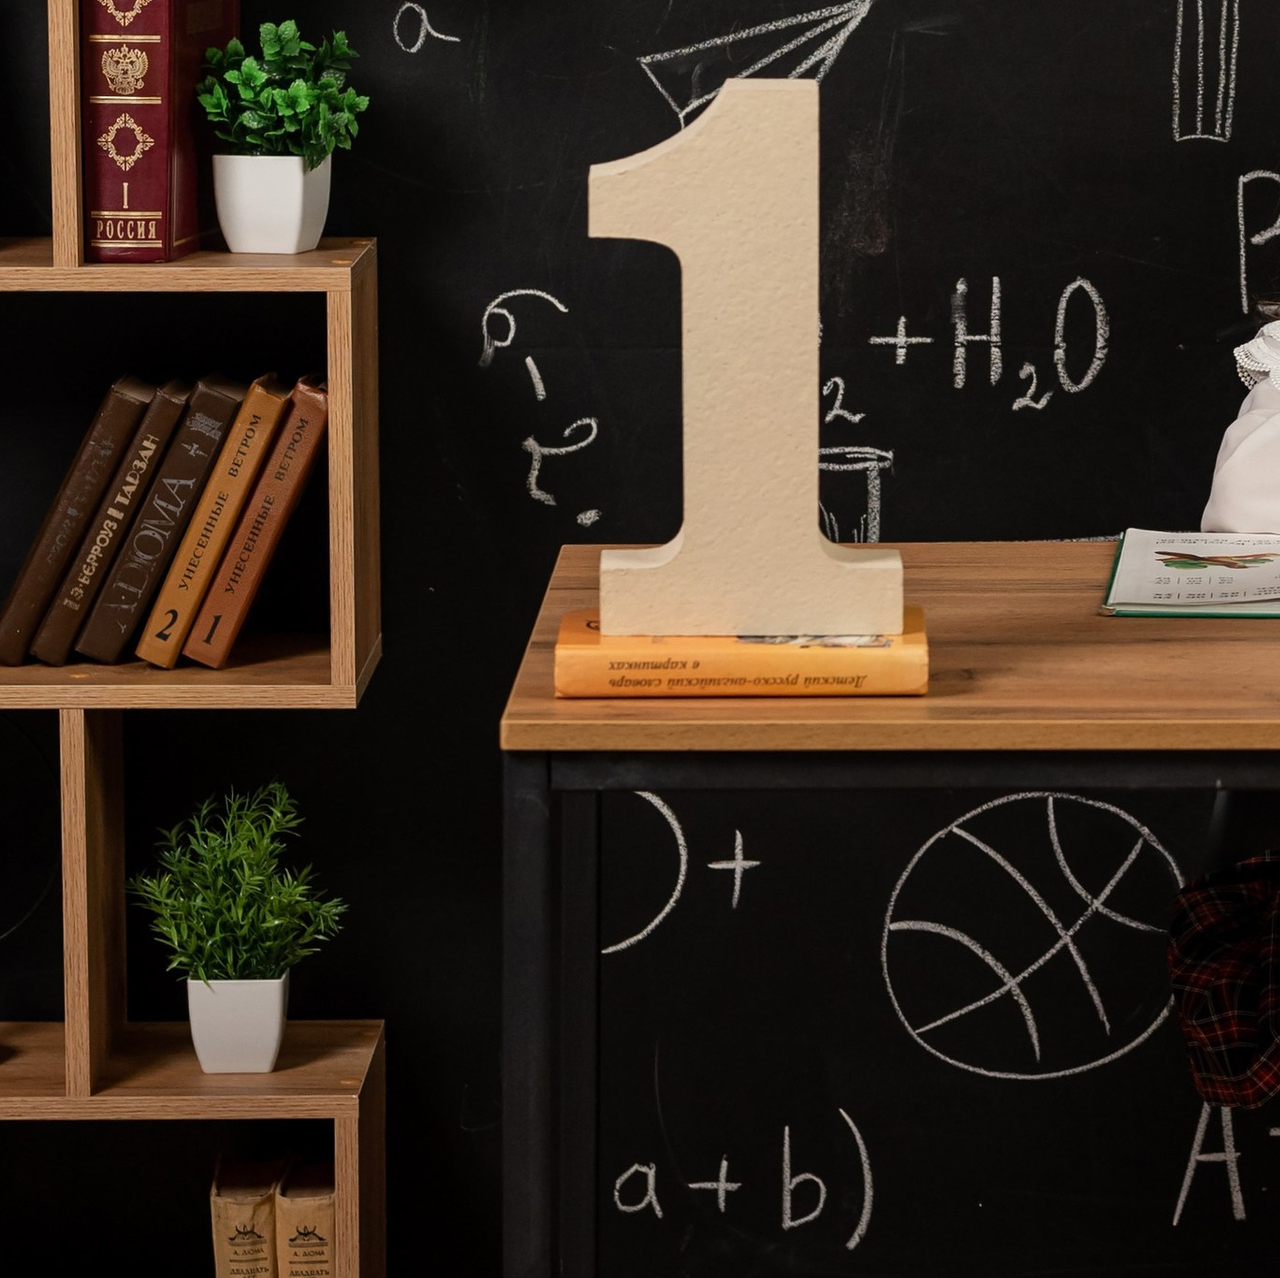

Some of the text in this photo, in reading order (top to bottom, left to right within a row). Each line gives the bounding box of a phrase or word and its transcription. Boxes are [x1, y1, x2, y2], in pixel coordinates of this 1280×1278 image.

[97, 220, 157, 239] РОССИЯ
[178, 490, 229, 591] УНЕСЕННЫЕ
[228, 413, 262, 478] ВЕТРОМ
[224, 417, 309, 594] УНЕСЕННЫЕ ВЕТРОМ
[155, 609, 179, 643] 2
[202, 614, 222, 646] 1
[608, 659, 688, 672] картинках
[608, 674, 867, 688] Детский русско-английский словарь
